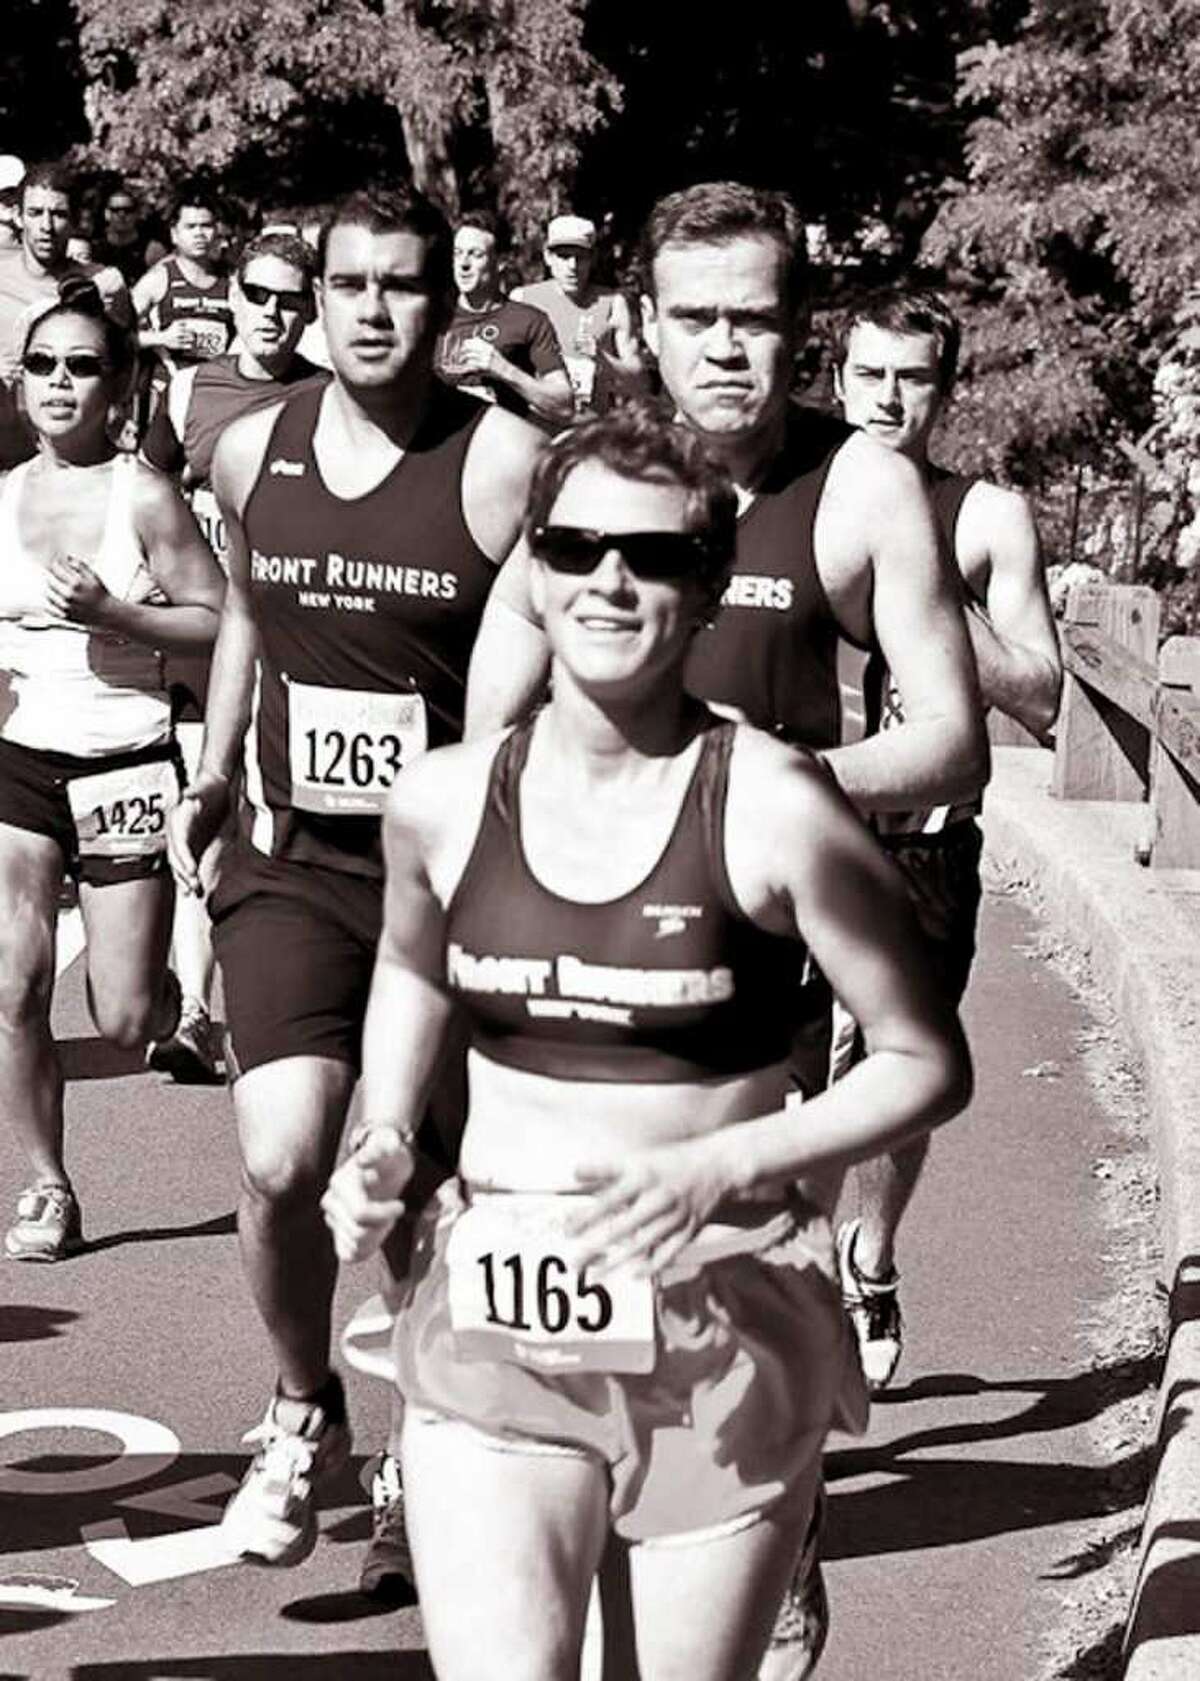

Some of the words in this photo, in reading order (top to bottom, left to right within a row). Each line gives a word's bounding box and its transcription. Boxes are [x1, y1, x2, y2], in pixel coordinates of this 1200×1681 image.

[251, 549, 317, 585] FRONT
[326, 553, 459, 600] RUNNERS
[299, 591, 331, 609] NEW
[333, 594, 377, 613] YORK
[305, 728, 403, 788] 1263
[92, 792, 165, 836] 1425
[477, 1252, 613, 1334] 1165
